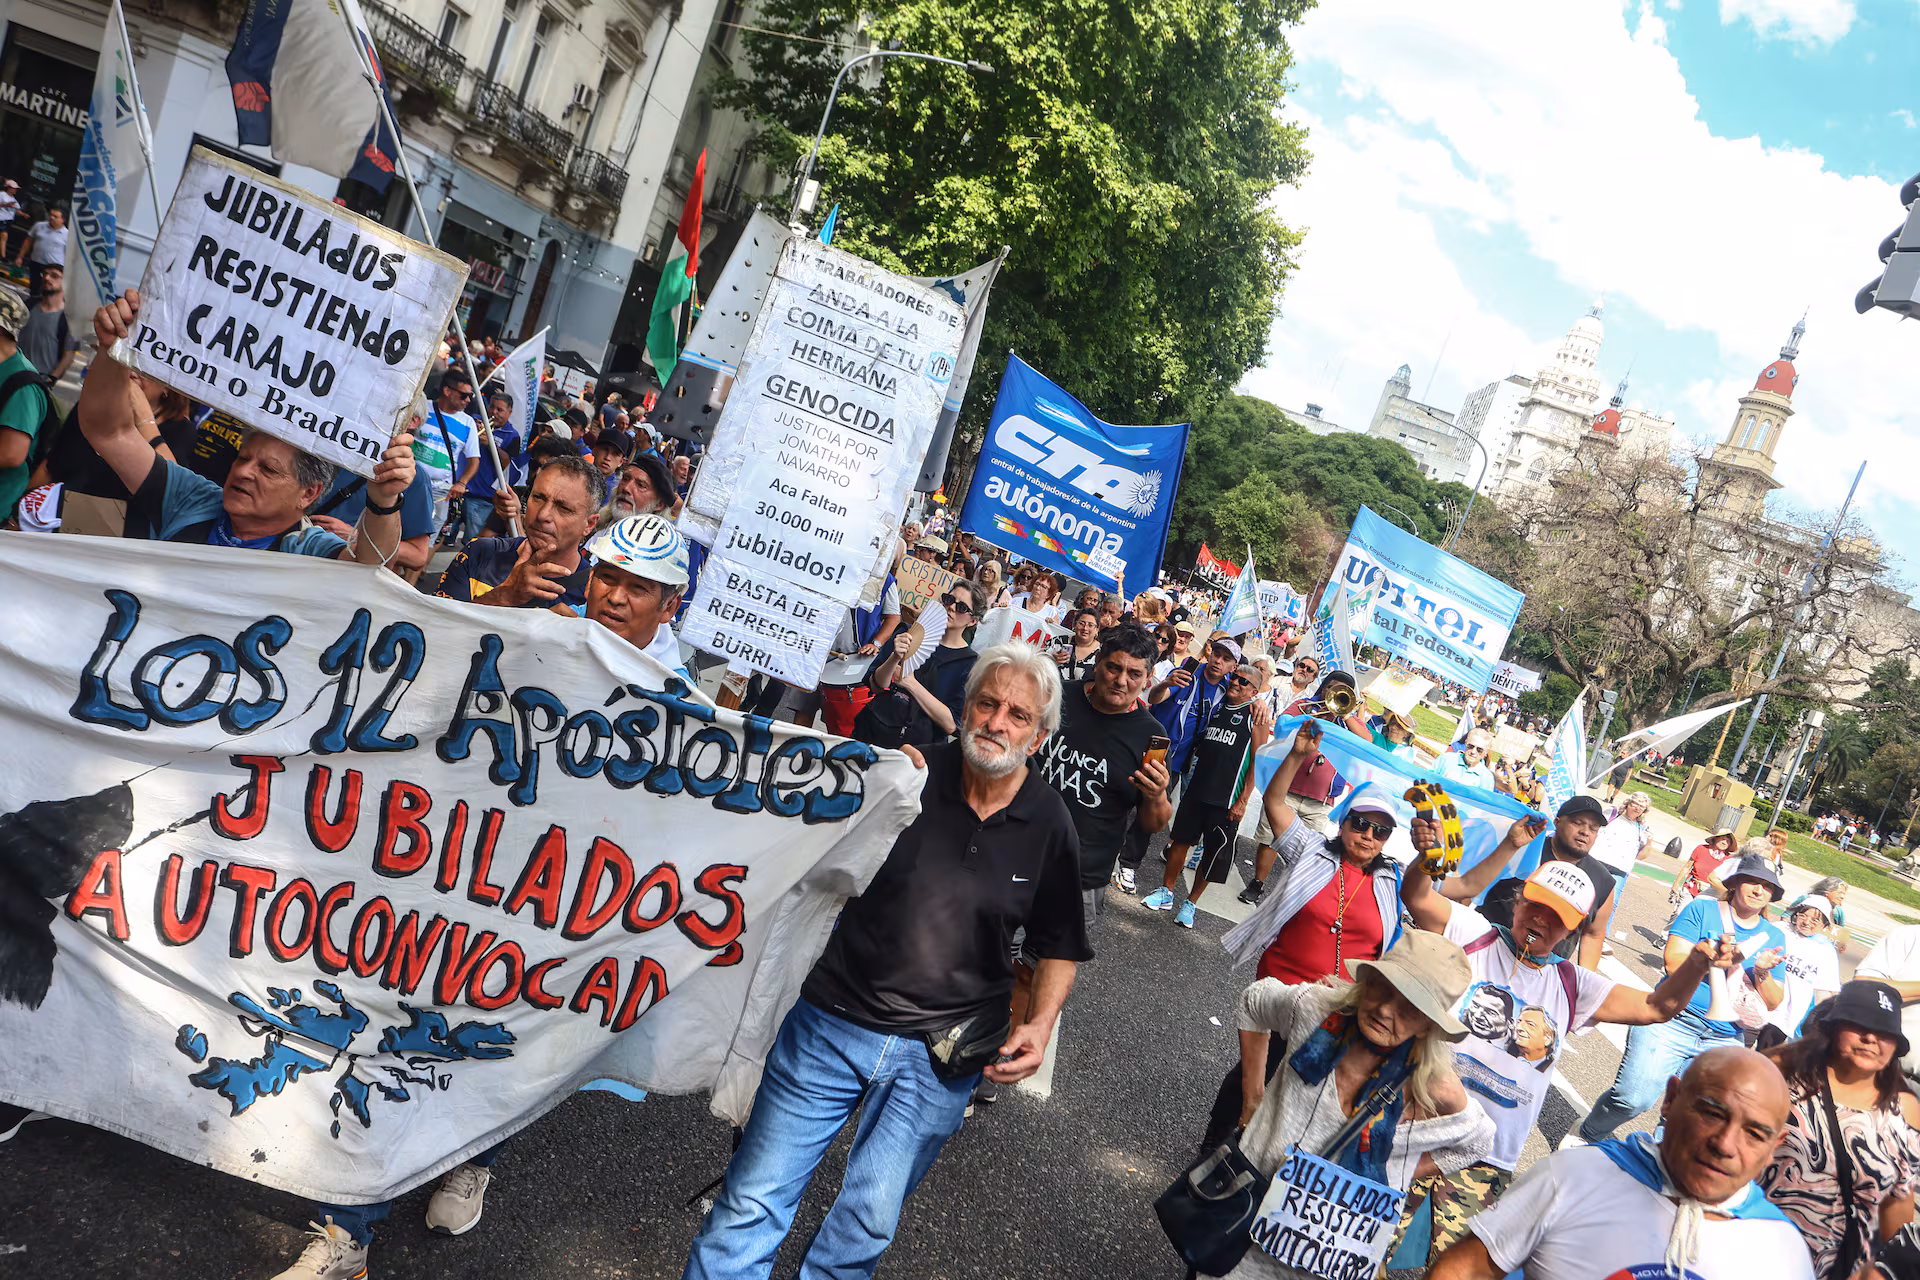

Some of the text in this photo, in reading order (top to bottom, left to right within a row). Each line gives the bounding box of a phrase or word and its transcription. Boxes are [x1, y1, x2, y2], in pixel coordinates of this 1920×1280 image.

[0, 82, 88, 129] MARTINE
[809, 283, 870, 320] ANDA
[896, 317, 919, 340] LA
[815, 257, 936, 317] TRABAJADORES
[937, 309, 958, 328] DE
[186, 303, 336, 397] CARAJO
[787, 306, 924, 372] COIMA DE TU
[791, 339, 897, 396] HERMANA
[133, 324, 382, 462] Peron o Braden
[765, 374, 896, 440] GENOCIDA
[774, 411, 879, 461] JUSTICIA POR
[779, 433, 861, 473] JONATHAN
[994, 413, 1148, 511] CTA
[768, 477, 848, 517] Aca Faltan
[776, 450, 851, 488] NAVARRO
[990, 456, 1016, 472] central
[1015, 467, 1026, 478] de
[1081, 498, 1092, 510] de
[1100, 511, 1137, 530] argentina
[754, 500, 812, 533] 30.000
[983, 474, 1125, 556] autónoma
[725, 525, 846, 585] jubilados!
[707, 597, 815, 655] REPRESION
[726, 572, 820, 625] BASTA DE
[1371, 611, 1474, 670] tal Federal
[310, 607, 426, 755] 12
[1039, 732, 1108, 783] NUNCA
[1041, 757, 1105, 808] MAS
[209, 755, 748, 950] JUBILADOS
[1281, 1186, 1381, 1244] RESISTEN
[1299, 1224, 1336, 1246] A LA
